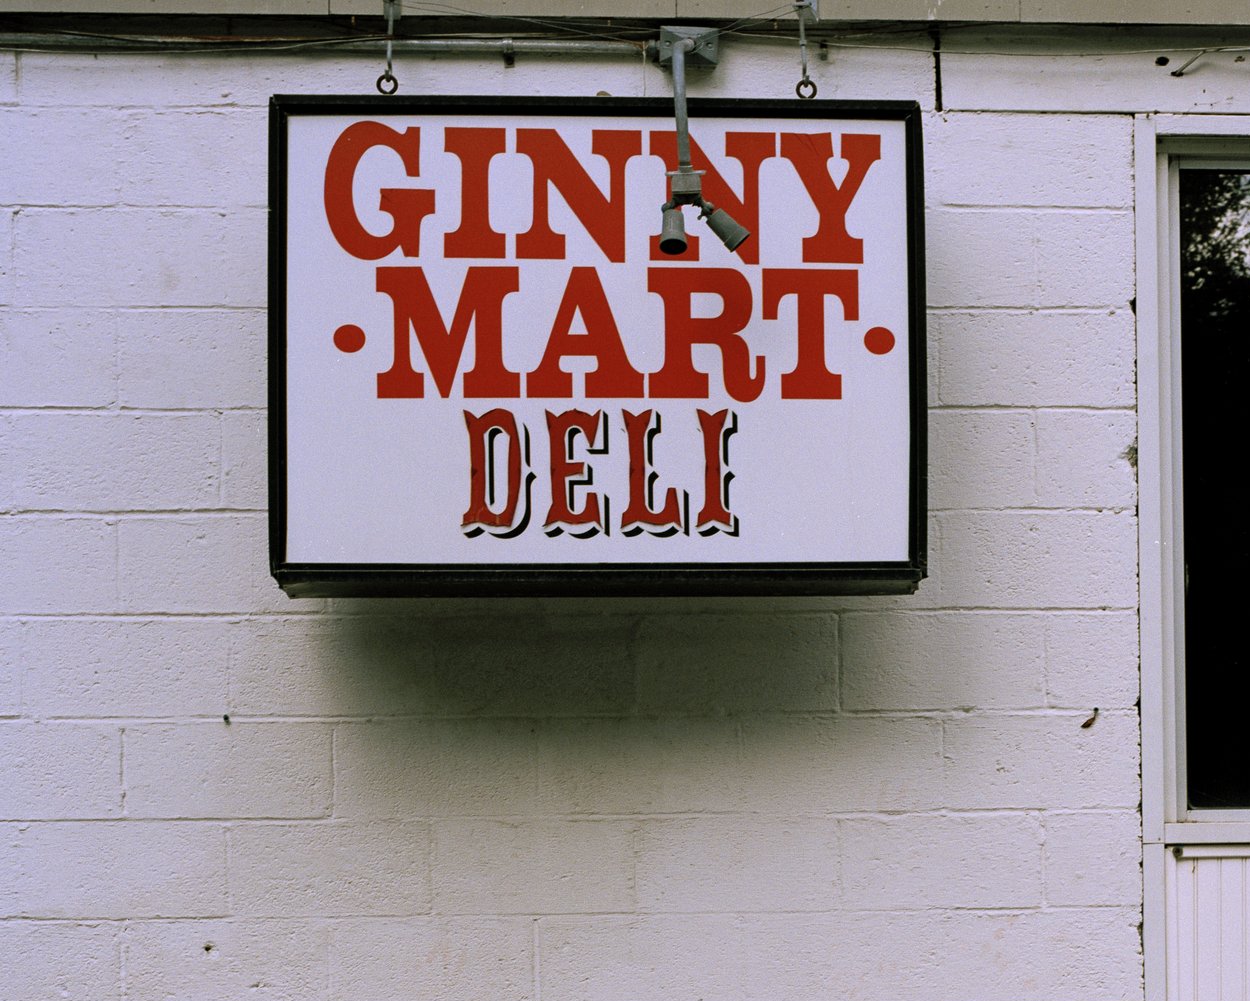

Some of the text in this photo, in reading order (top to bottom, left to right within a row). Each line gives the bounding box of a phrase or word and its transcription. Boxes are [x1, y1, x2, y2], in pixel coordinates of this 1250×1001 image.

[323, 120, 882, 265] GINNY
[375, 265, 860, 403] MART
[460, 407, 741, 539] DELI
